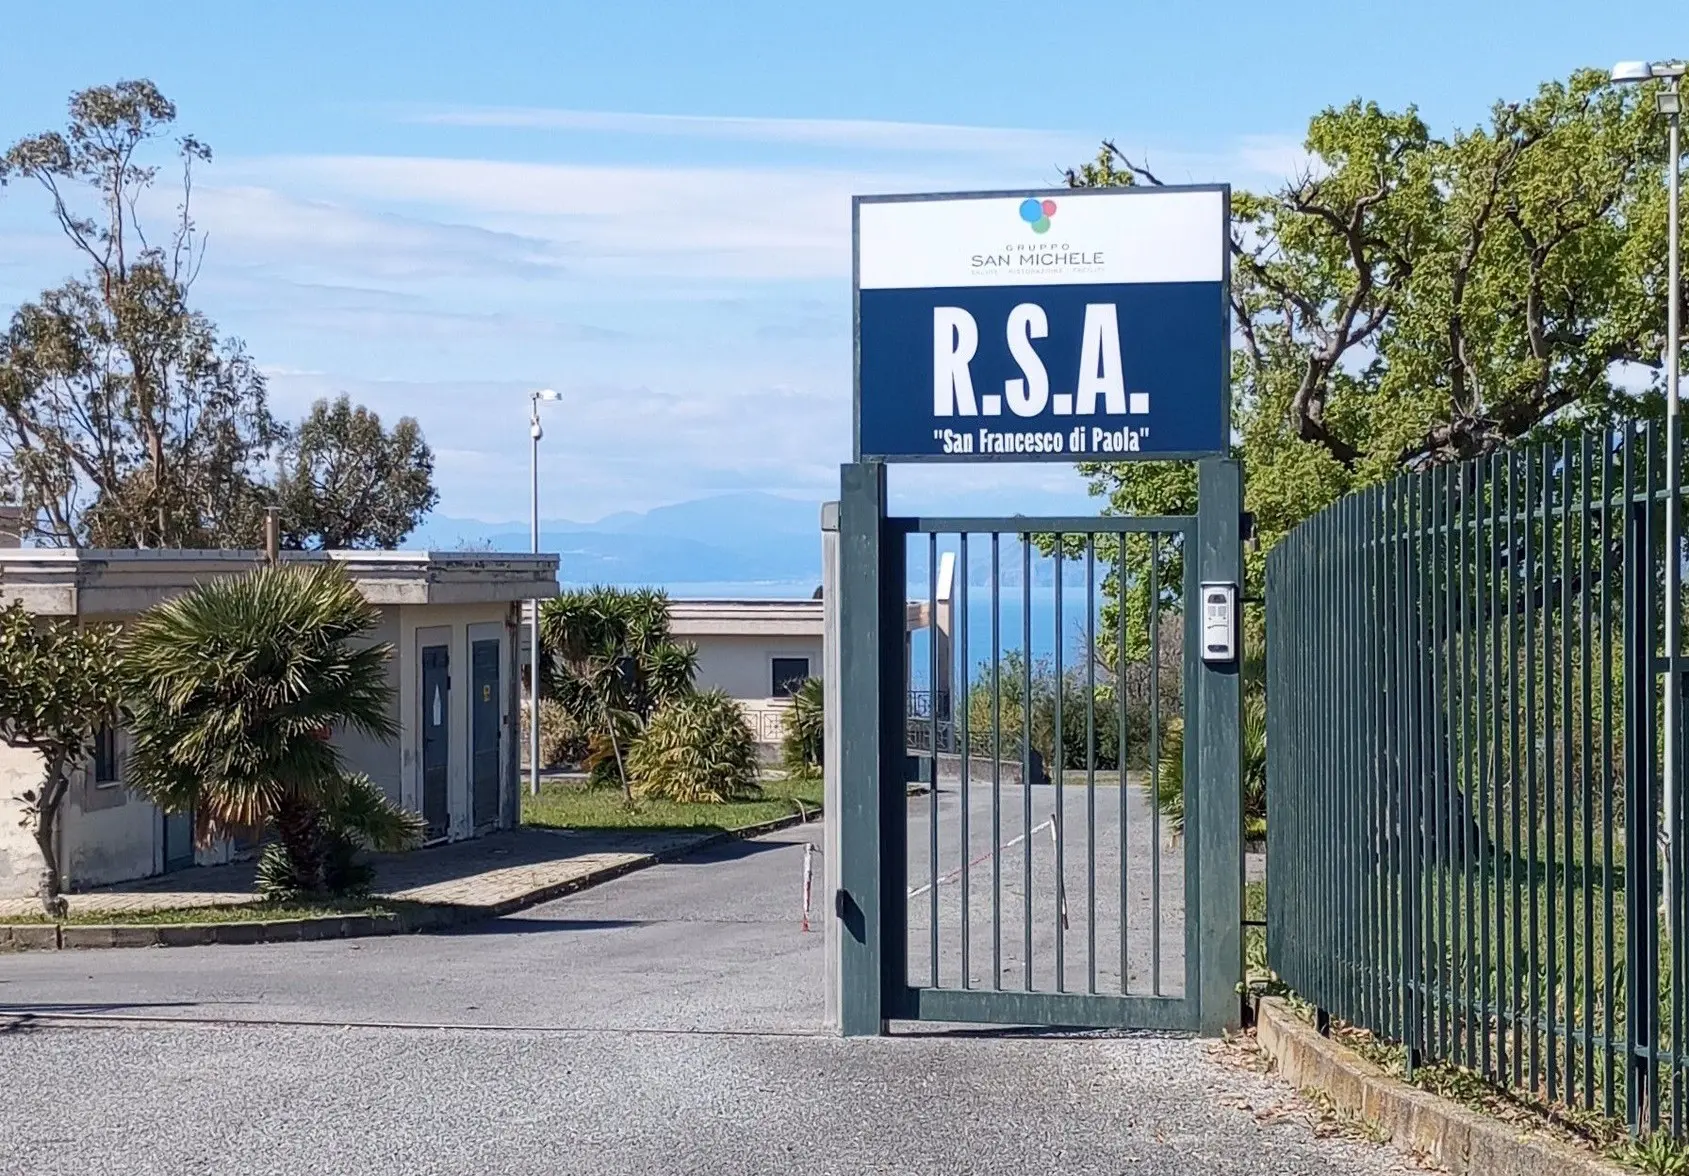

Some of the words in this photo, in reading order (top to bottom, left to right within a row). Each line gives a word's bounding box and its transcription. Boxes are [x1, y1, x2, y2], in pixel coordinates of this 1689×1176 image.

[1005, 243, 1070, 252] GRUPPO
[971, 254, 1011, 267] SAN
[1019, 252, 1105, 266] MICHELE
[933, 302, 1150, 418] R.S.A.
[933, 428, 974, 453] "San
[979, 429, 1064, 453] Francesco
[1069, 426, 1086, 453] di
[1092, 426, 1150, 452] Paola"
